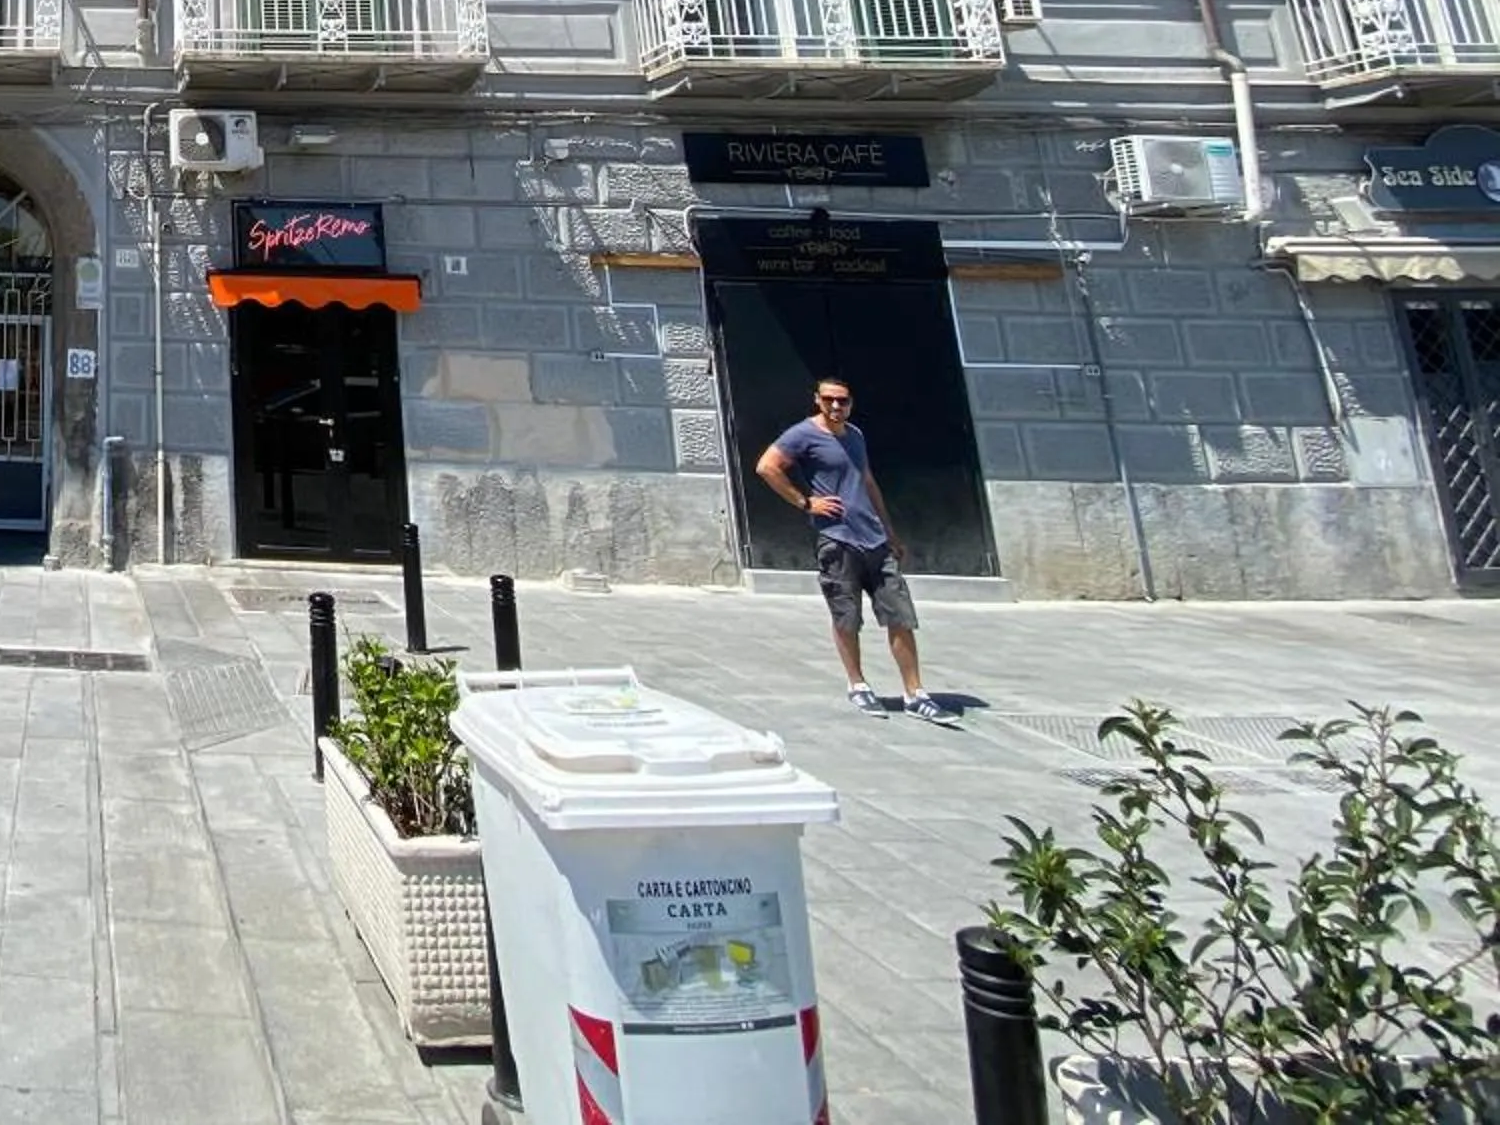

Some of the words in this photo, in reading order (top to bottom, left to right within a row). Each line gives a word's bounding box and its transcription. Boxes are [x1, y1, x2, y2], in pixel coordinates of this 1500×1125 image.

[727, 141, 820, 164] RIVIERA
[1381, 166, 1424, 186] Sea
[1428, 165, 1477, 186] Side
[829, 226, 861, 240] food
[70, 352, 91, 374] 88
[637, 881, 673, 898] CARTA
[675, 881, 683, 898] E
[685, 877, 752, 898] CARTONCINO
[667, 902, 728, 918] CARTA
